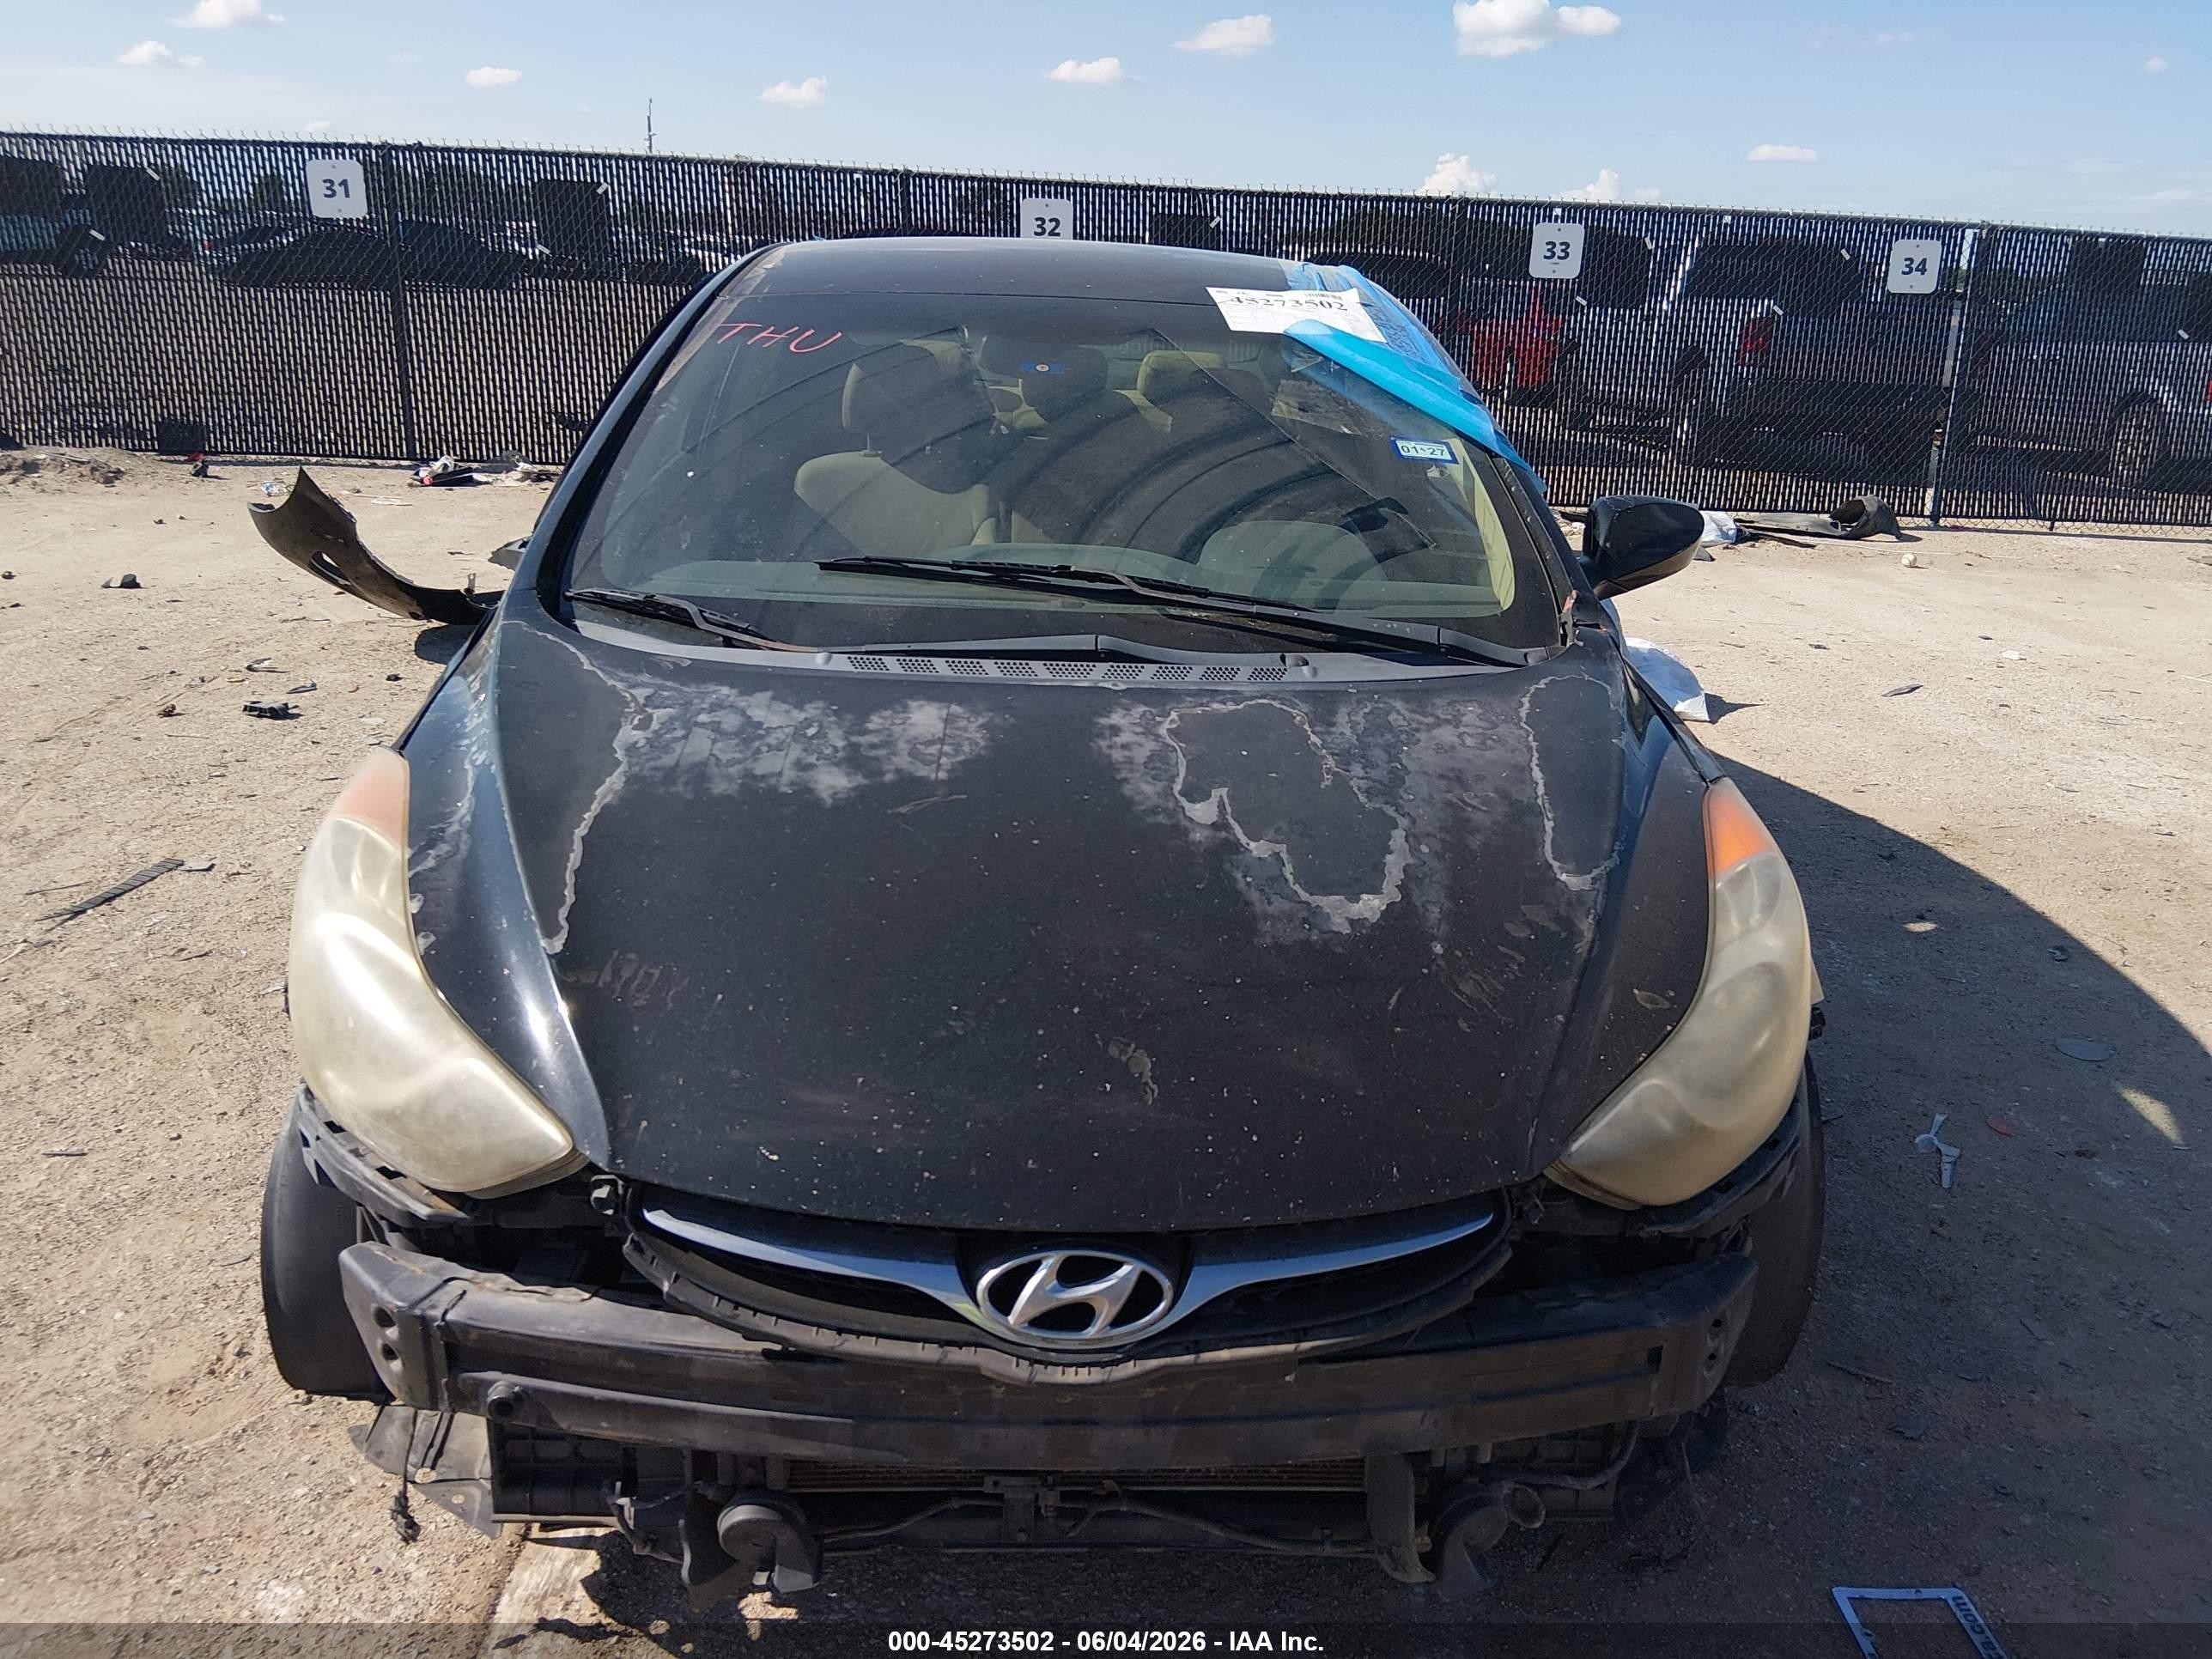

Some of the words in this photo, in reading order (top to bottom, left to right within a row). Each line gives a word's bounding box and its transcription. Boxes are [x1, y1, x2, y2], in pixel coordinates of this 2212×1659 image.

[322, 179, 350, 198] 31
[1033, 216, 1061, 237] 32
[1543, 240, 1571, 260] 33
[1901, 257, 1928, 276] 34
[1230, 295, 1348, 312] 45273502
[717, 322, 842, 353] THU
[1401, 445, 1419, 454] 01
[1427, 447, 1445, 457] 27
